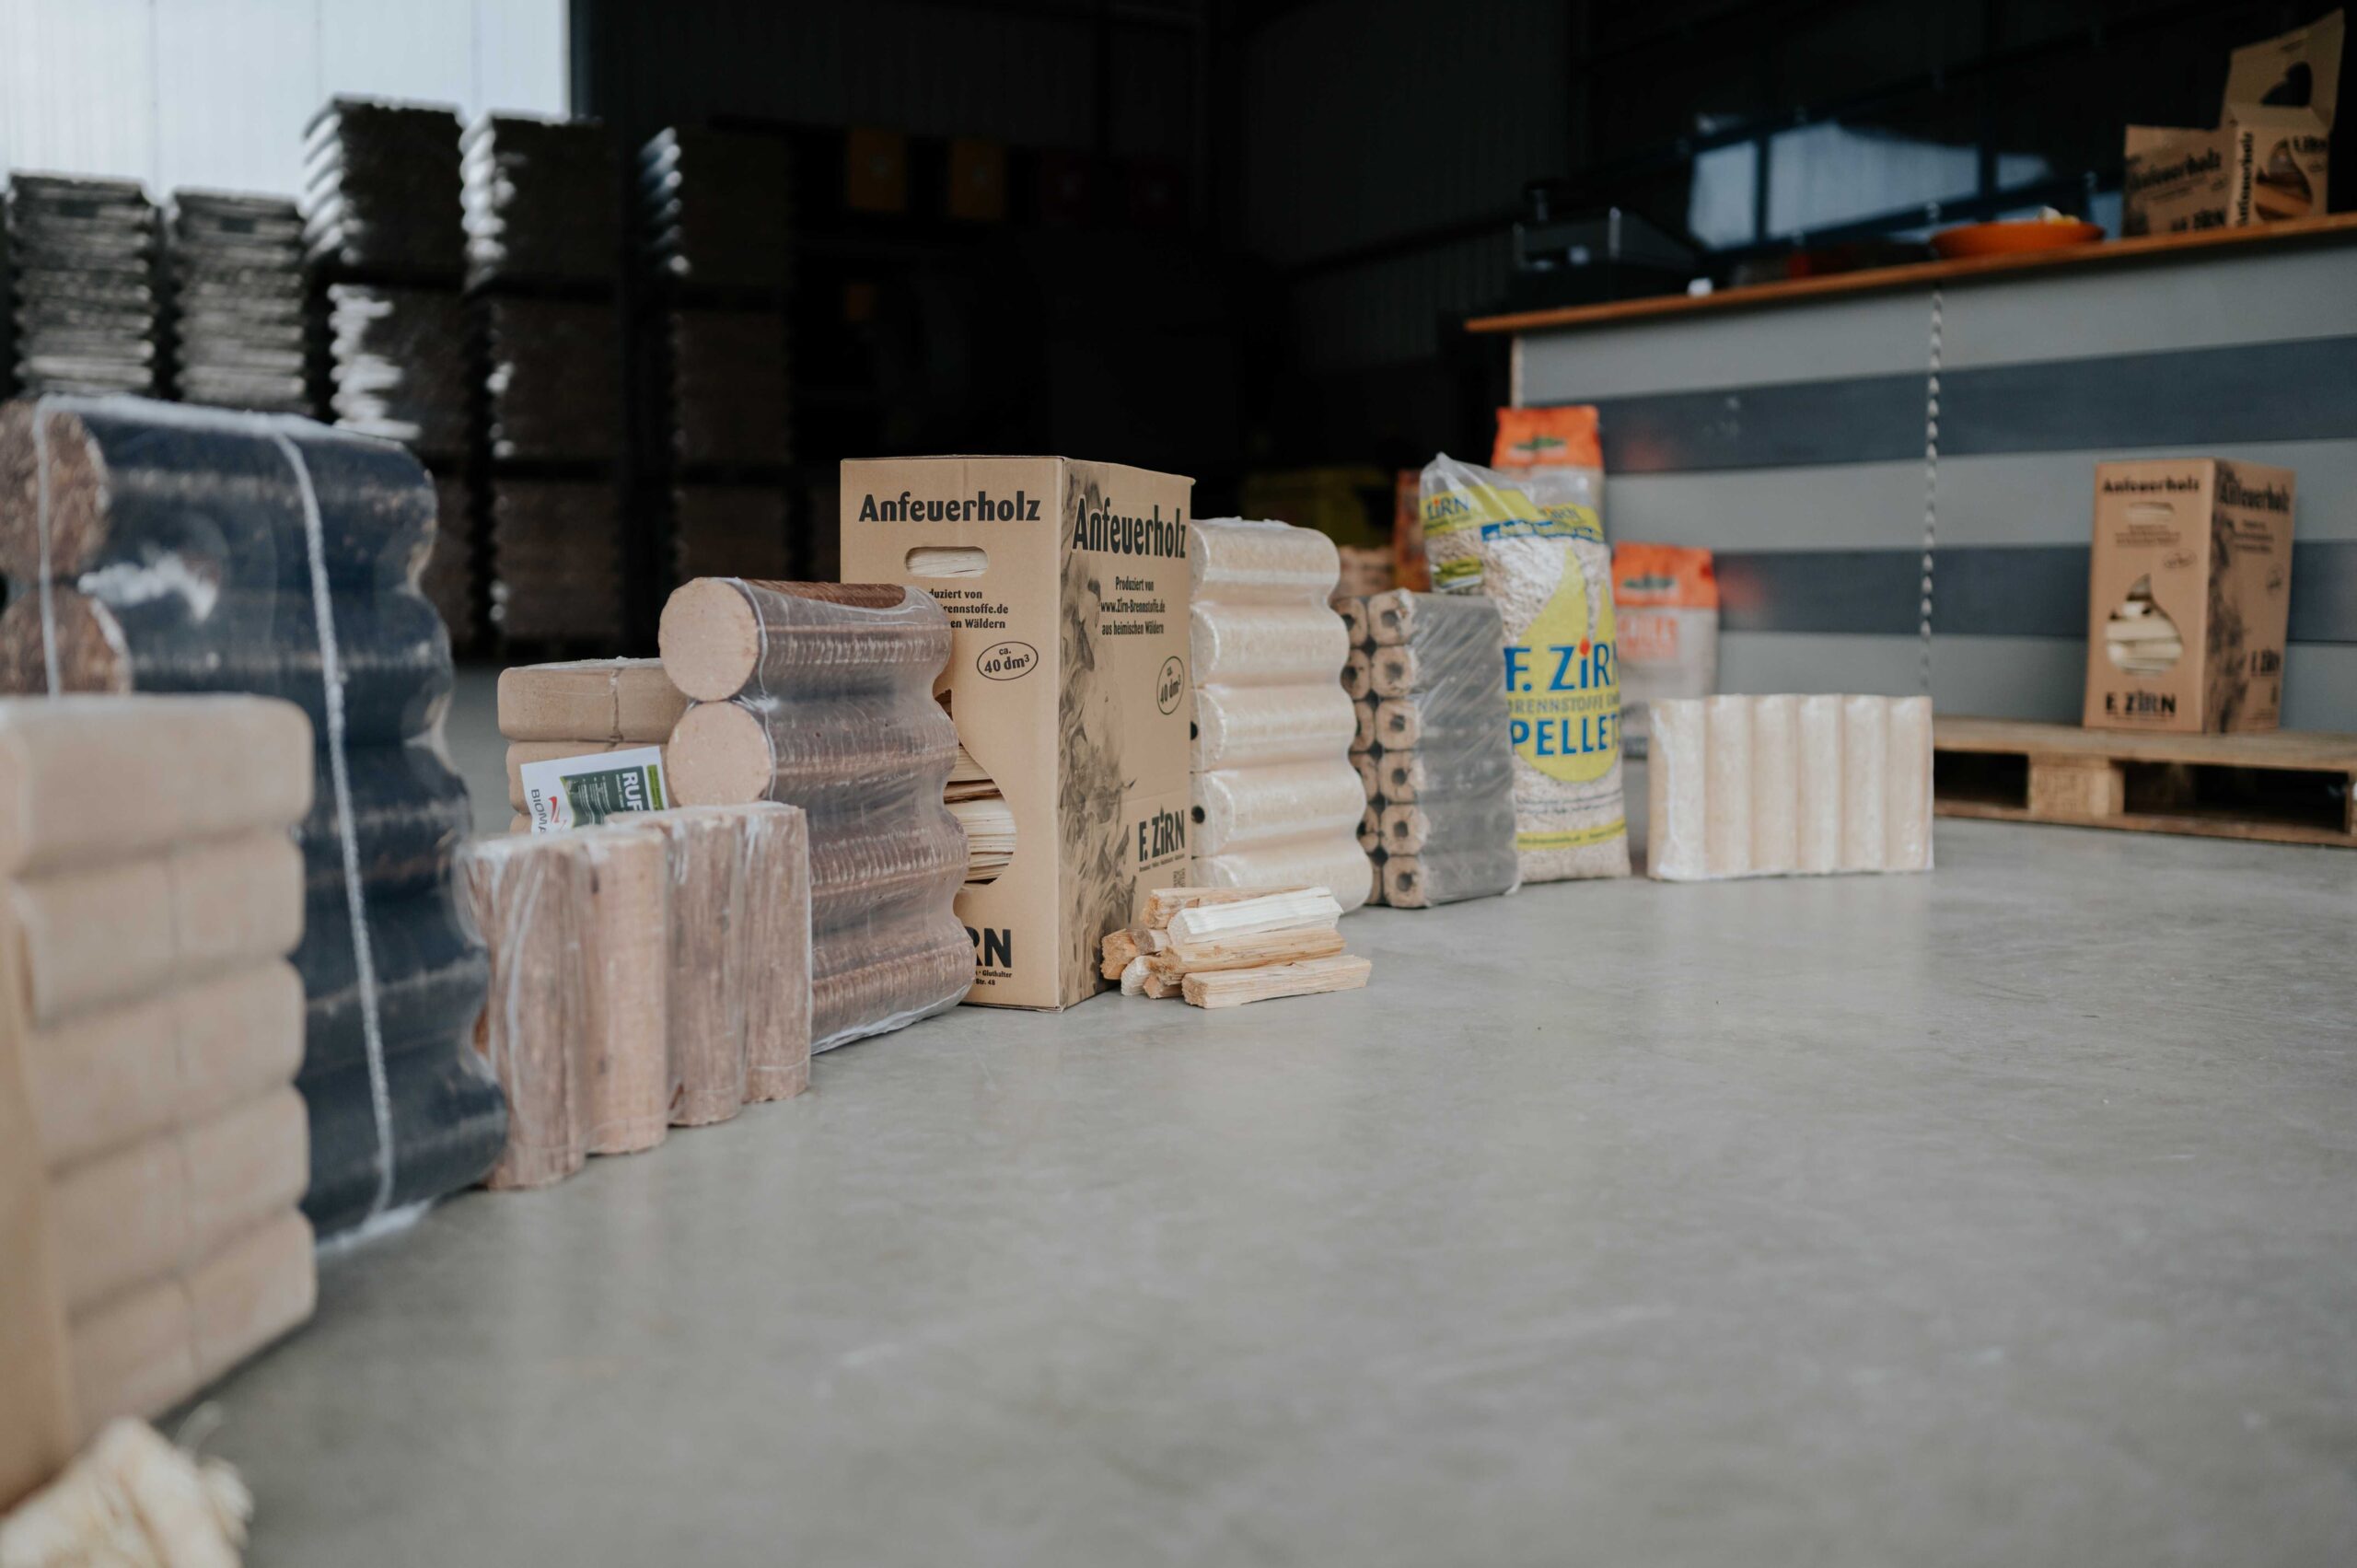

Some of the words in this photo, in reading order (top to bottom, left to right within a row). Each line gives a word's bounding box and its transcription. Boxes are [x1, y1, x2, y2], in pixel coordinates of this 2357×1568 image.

[858, 491, 1041, 522] Anfeuerholz
[1072, 497, 1187, 559] Anfeuerholz
[1115, 575, 1144, 591] Produziert
[1144, 581, 1155, 591] von
[964, 591, 983, 599] von
[941, 603, 1009, 614] rennstoffe.de
[1100, 597, 1166, 613] www.Zirn-Brennstoffe.de
[965, 618, 1006, 629] Wäldern
[1101, 624, 1113, 635] aus
[1113, 620, 1144, 635] heimischen
[999, 647, 1012, 656] ca.
[984, 659, 1001, 674] 40
[1503, 647, 1532, 691] F.
[1160, 683, 1168, 705] 40
[622, 772, 644, 811] RUF
[1139, 820, 1148, 862] F.
[981, 970, 1013, 978] Gluthalter
